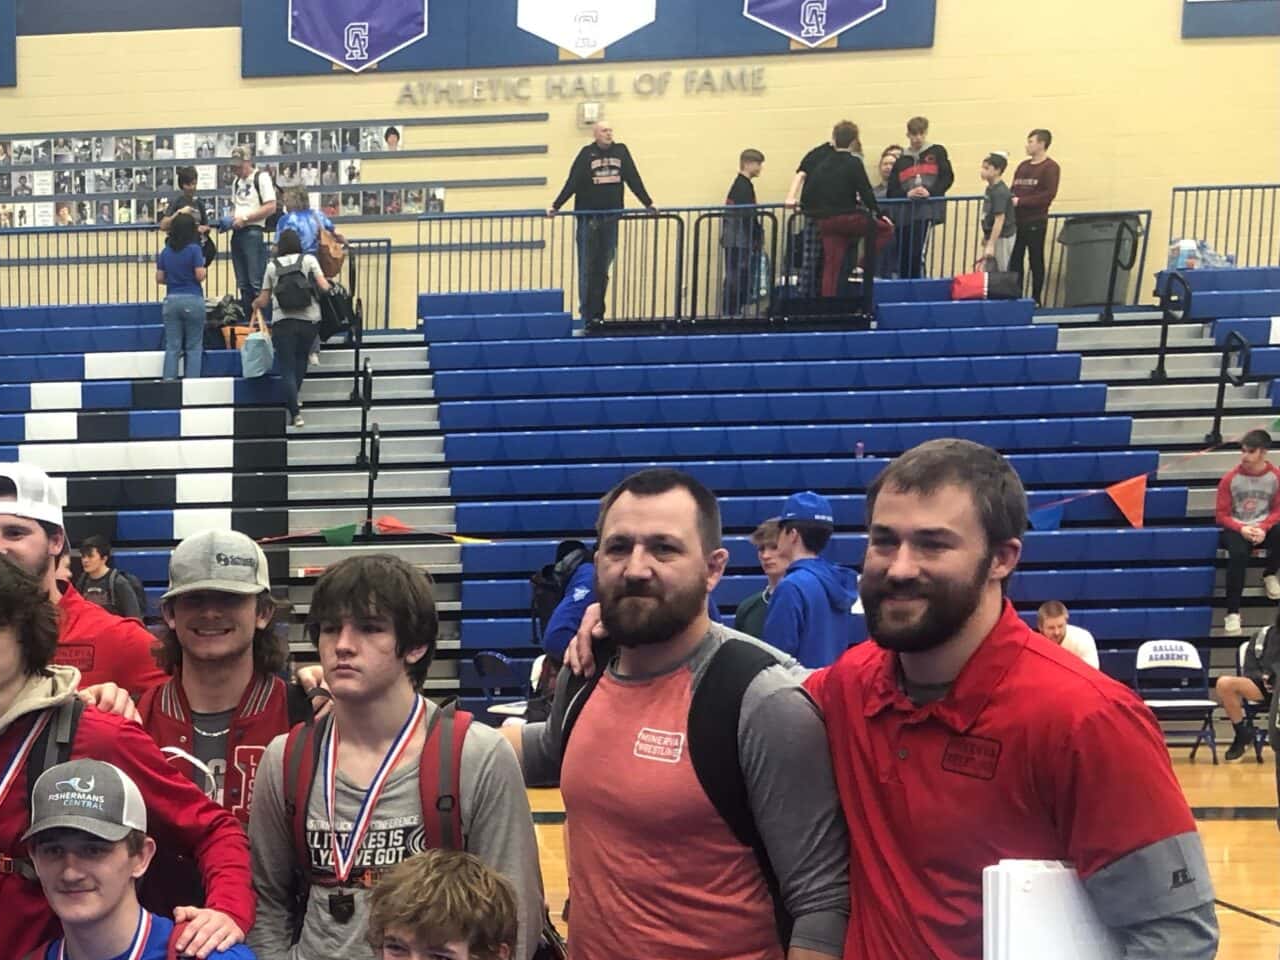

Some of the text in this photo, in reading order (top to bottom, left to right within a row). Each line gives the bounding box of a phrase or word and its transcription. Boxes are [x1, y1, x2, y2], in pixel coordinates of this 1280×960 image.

[397, 67, 766, 105] ATHLETIC HALL OF FAME
[1148, 653, 1189, 662] ACADEMY
[640, 732, 679, 748] MINERVA
[48, 791, 105, 803] FISHERMANS
[63, 800, 104, 812] CENTRAL
[388, 829, 404, 848] IS
